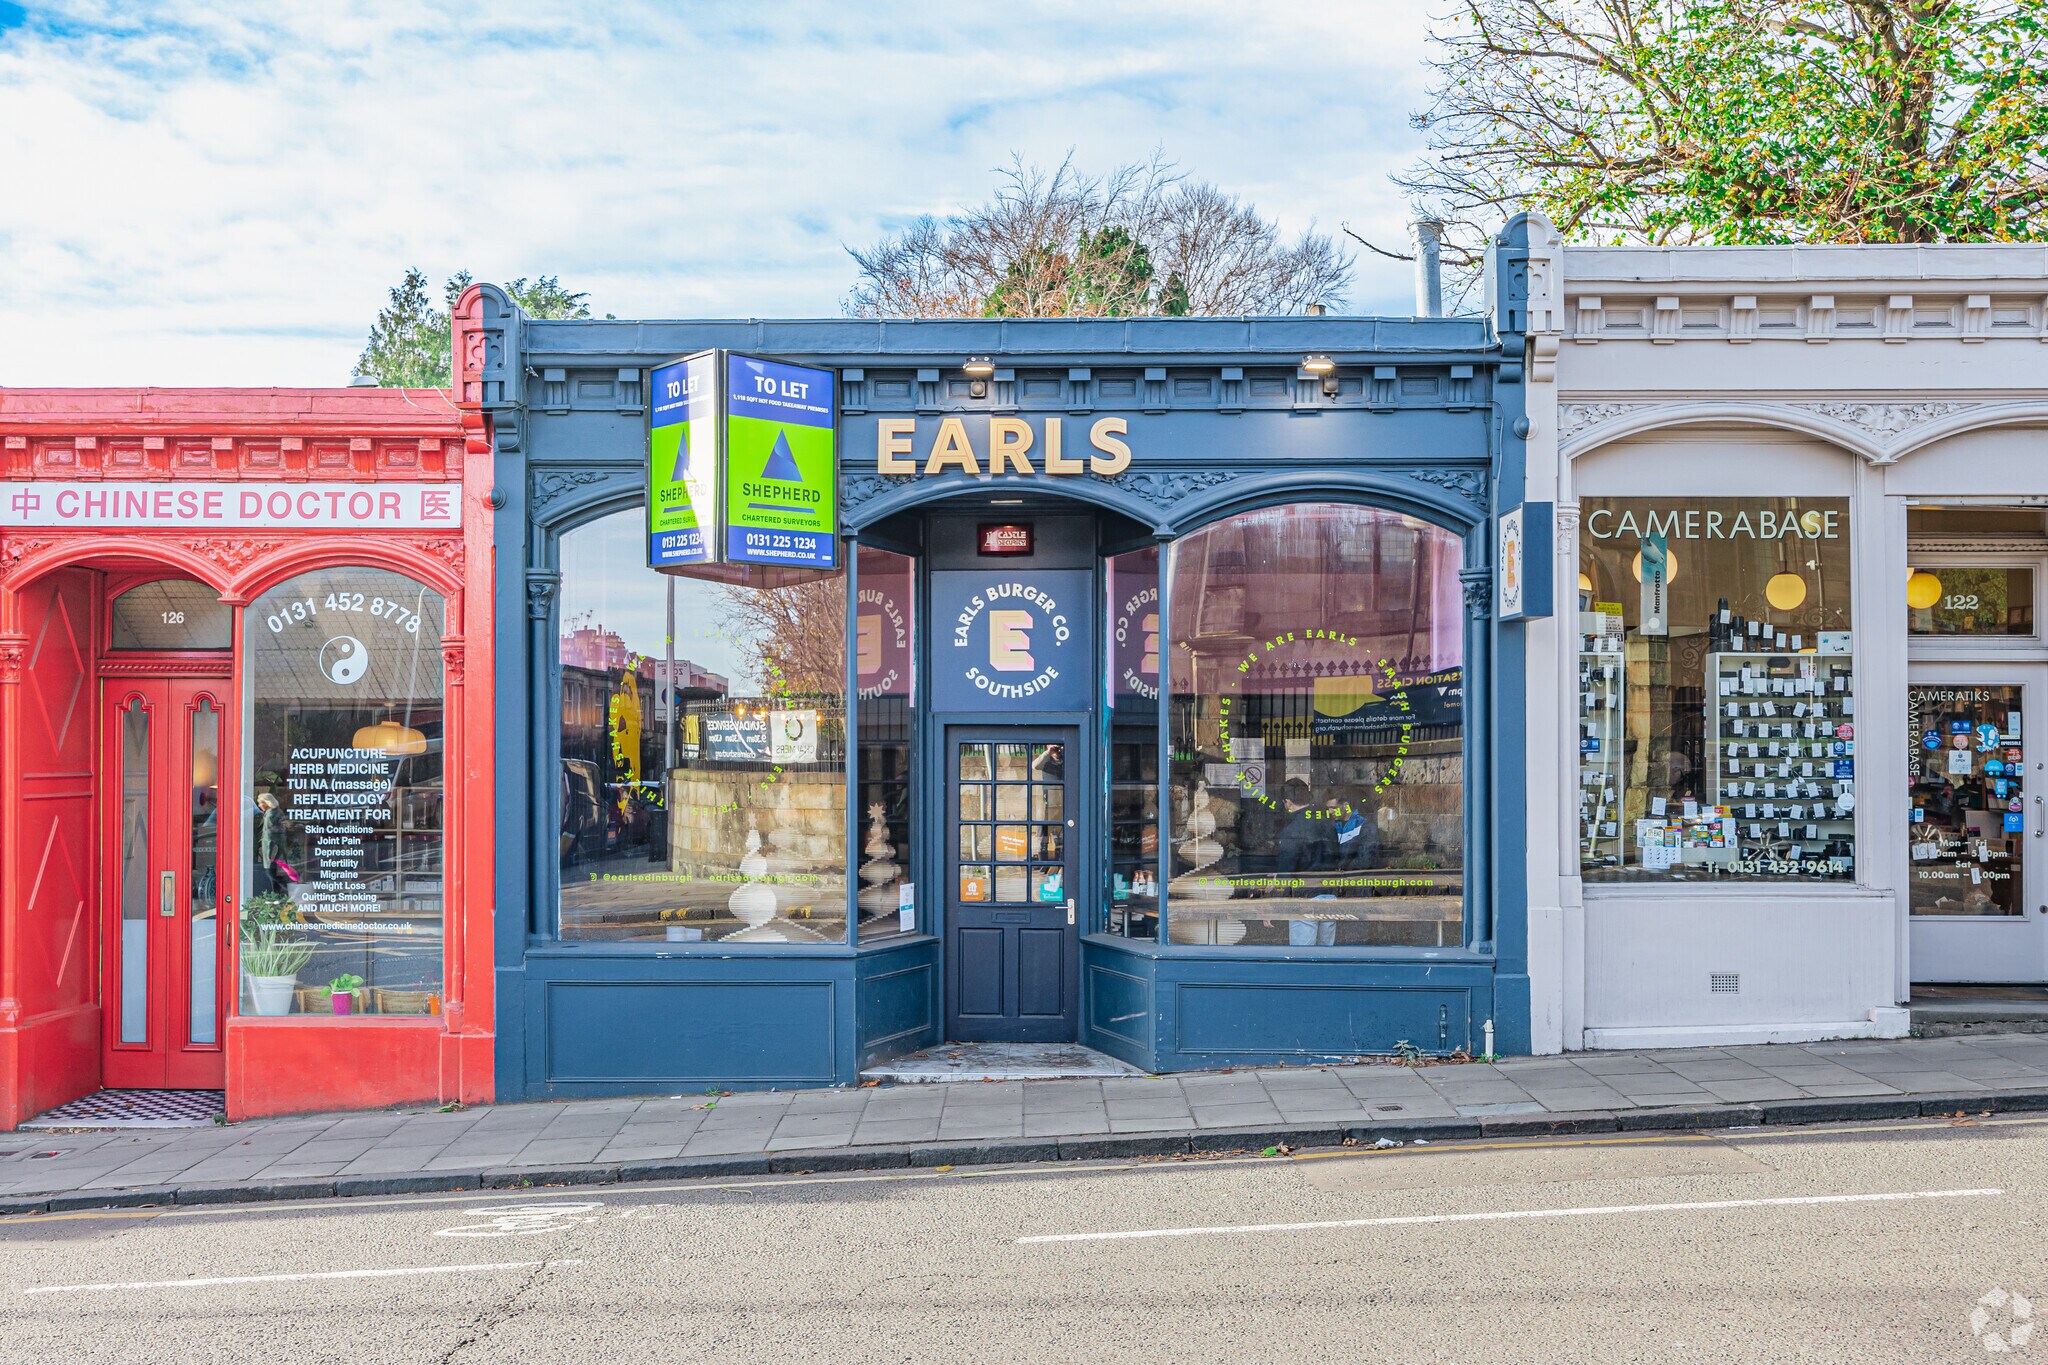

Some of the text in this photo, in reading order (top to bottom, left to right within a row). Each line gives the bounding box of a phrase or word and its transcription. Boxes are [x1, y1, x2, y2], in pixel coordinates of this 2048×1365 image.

[667, 375, 699, 399] TO LET
[754, 375, 808, 400] TO LET
[782, 401, 807, 410] TAKEAWAY
[807, 405, 829, 414] PREMISES
[877, 416, 1132, 475] EARLS
[742, 482, 821, 503] SHEPHERD
[11, 488, 451, 521] 中 CHINESE DOCTOR 医
[742, 513, 821, 527] CHARTERED SURVEYORS
[1587, 510, 1839, 540] CAMERABASE
[661, 532, 703, 549] 0131 225 1234
[746, 533, 817, 550] 0131 225 1234
[997, 531, 1027, 539] CASTLE
[746, 548, 816, 560] WWW.SHEPHERD.CO.UK
[1944, 594, 1979, 610] 122
[161, 611, 185, 625] 126
[267, 593, 422, 634] 0131 452 8778
[954, 583, 1070, 647] EARLS BURGER CO.
[989, 609, 1035, 672] E
[1265, 632, 1295, 652] ARE
[1306, 629, 1357, 647] EARLS
[1238, 652, 1259, 674] WE
[765, 657, 795, 709] SMASH
[965, 665, 1060, 698] SOUTHSIDE
[1378, 658, 1410, 711] SMASH
[1908, 690, 1990, 702] CAMERATIKS
[609, 697, 625, 761] SHAKES
[1218, 697, 1236, 763] SHAKES
[291, 748, 387, 759] ACUPUNCTURE
[1375, 723, 1411, 794] BURGERS
[289, 763, 389, 775] HERB MEDICINE
[287, 779, 392, 791] TUI NA (massage)
[1235, 771, 1277, 810] THICK
[293, 794, 385, 805] REFLEXOLOGY
[287, 809, 391, 820] TREATMENT FOR
[1305, 806, 1352, 820] FRIES
[305, 825, 374, 834] Skin Conditions
[317, 836, 361, 845] Joint Pain
[1975, 839, 1987, 847] Fri
[314, 848, 364, 858] Depression
[320, 859, 358, 869] Infertility
[1706, 860, 1844, 874] T: 0131 452 9614
[320, 870, 358, 880] Migraine
[1918, 871, 1959, 879] 10.00am
[312, 881, 366, 892] Weight Loss
[1213, 878, 1434, 888] @earlsedinburgh earlsedinburgh.com
[302, 892, 377, 902] Quitting Smoking
[297, 904, 381, 912] AND MUCH MORE!
[261, 922, 412, 931] www.chinesemedicinedoctor.co.uk
